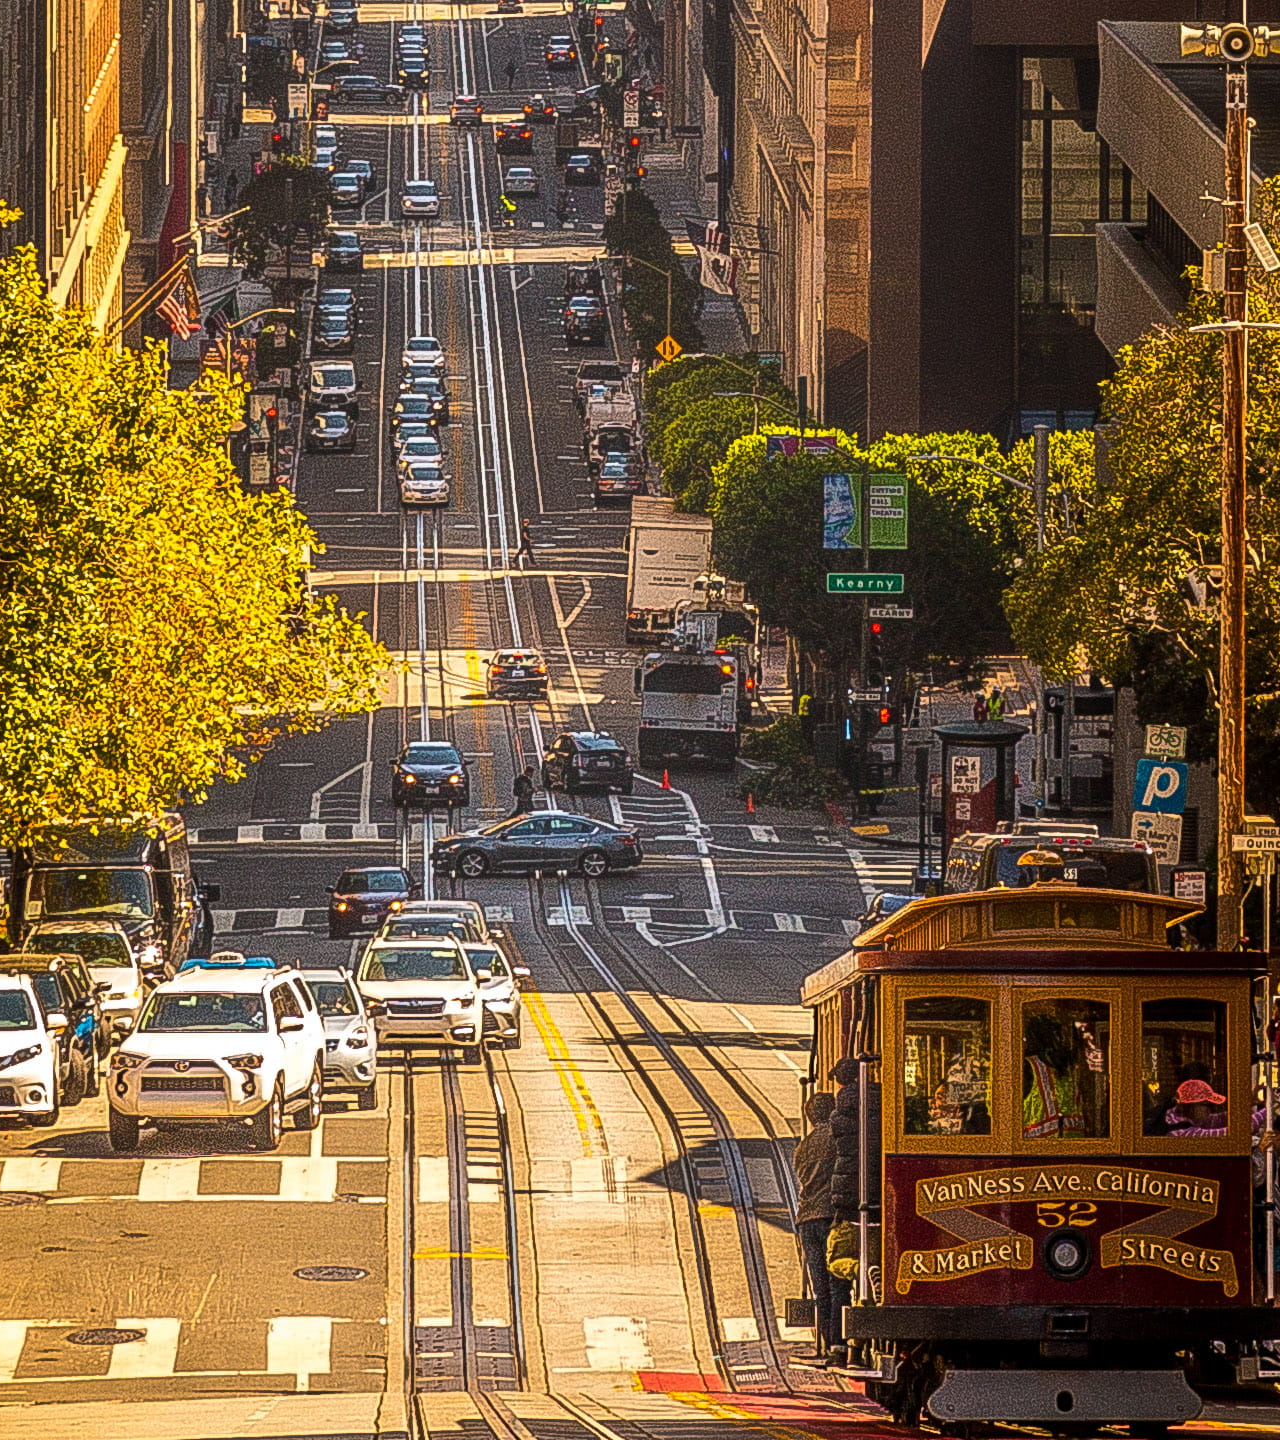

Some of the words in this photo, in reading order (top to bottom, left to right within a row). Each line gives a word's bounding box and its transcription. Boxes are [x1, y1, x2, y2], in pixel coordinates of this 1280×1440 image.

[836, 577, 895, 591] Kearny
[872, 609, 912, 617] KEARNY
[922, 1180, 965, 1204] Van
[967, 1173, 1026, 1198] Ness
[1095, 1170, 1216, 1205] California
[1036, 1201, 1098, 1228] 52
[911, 1253, 929, 1275] &
[935, 1239, 1022, 1272] Market
[1121, 1237, 1223, 1273] Streets
